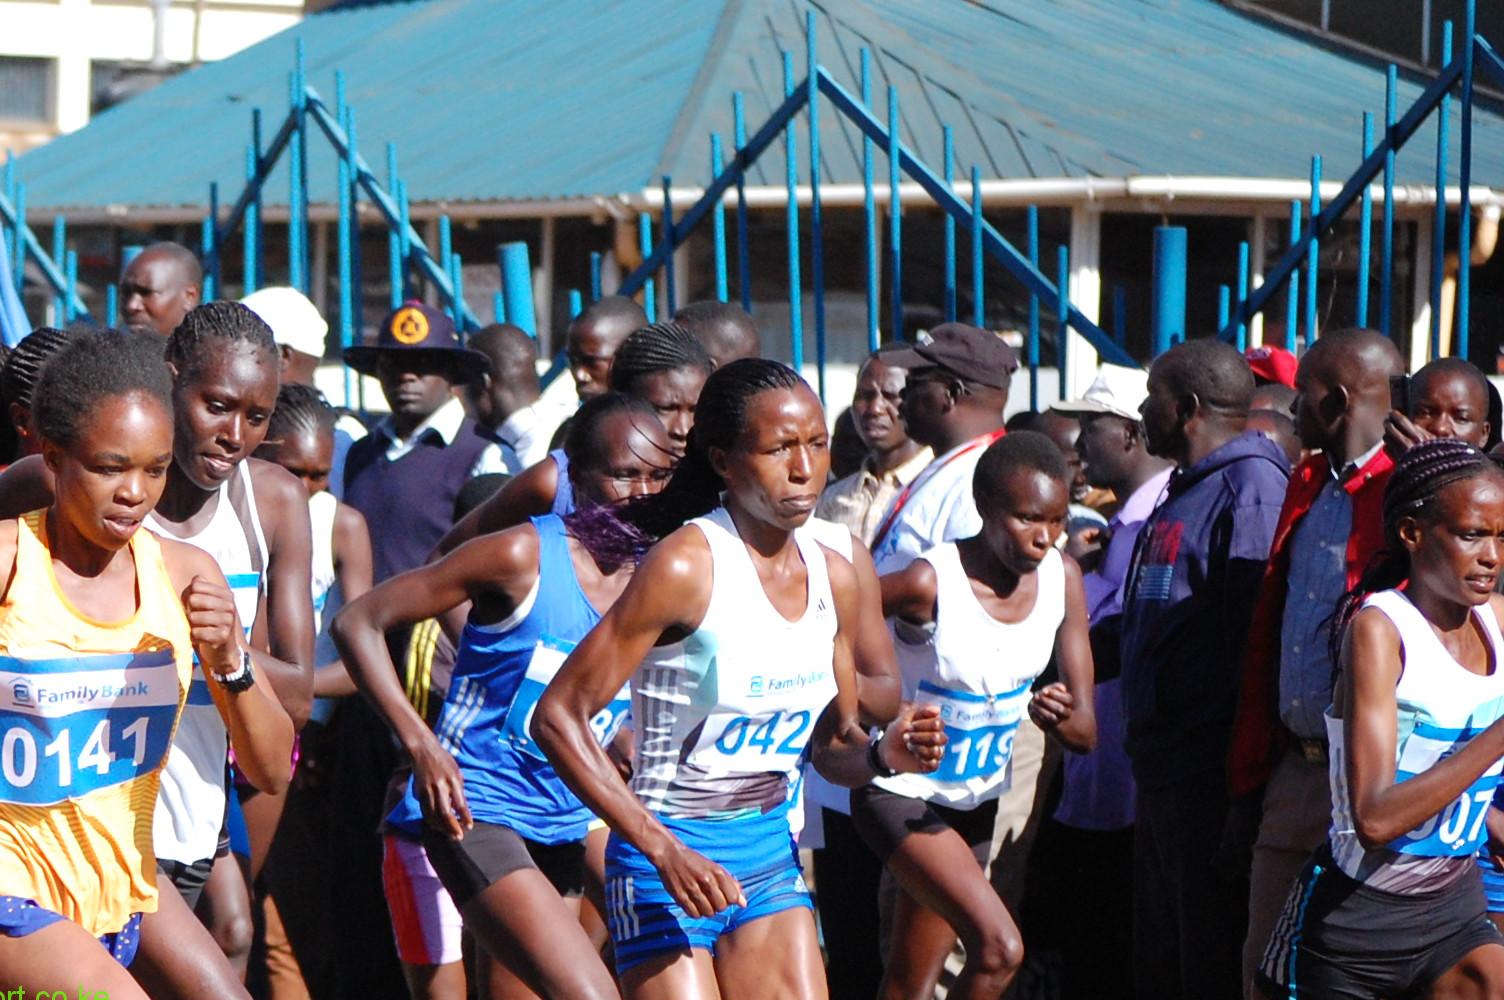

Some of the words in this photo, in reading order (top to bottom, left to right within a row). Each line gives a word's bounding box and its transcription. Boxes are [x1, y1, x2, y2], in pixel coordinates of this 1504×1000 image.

[37, 685, 100, 704] Family
[101, 681, 149, 699] Bank
[1, 716, 150, 788] 0141
